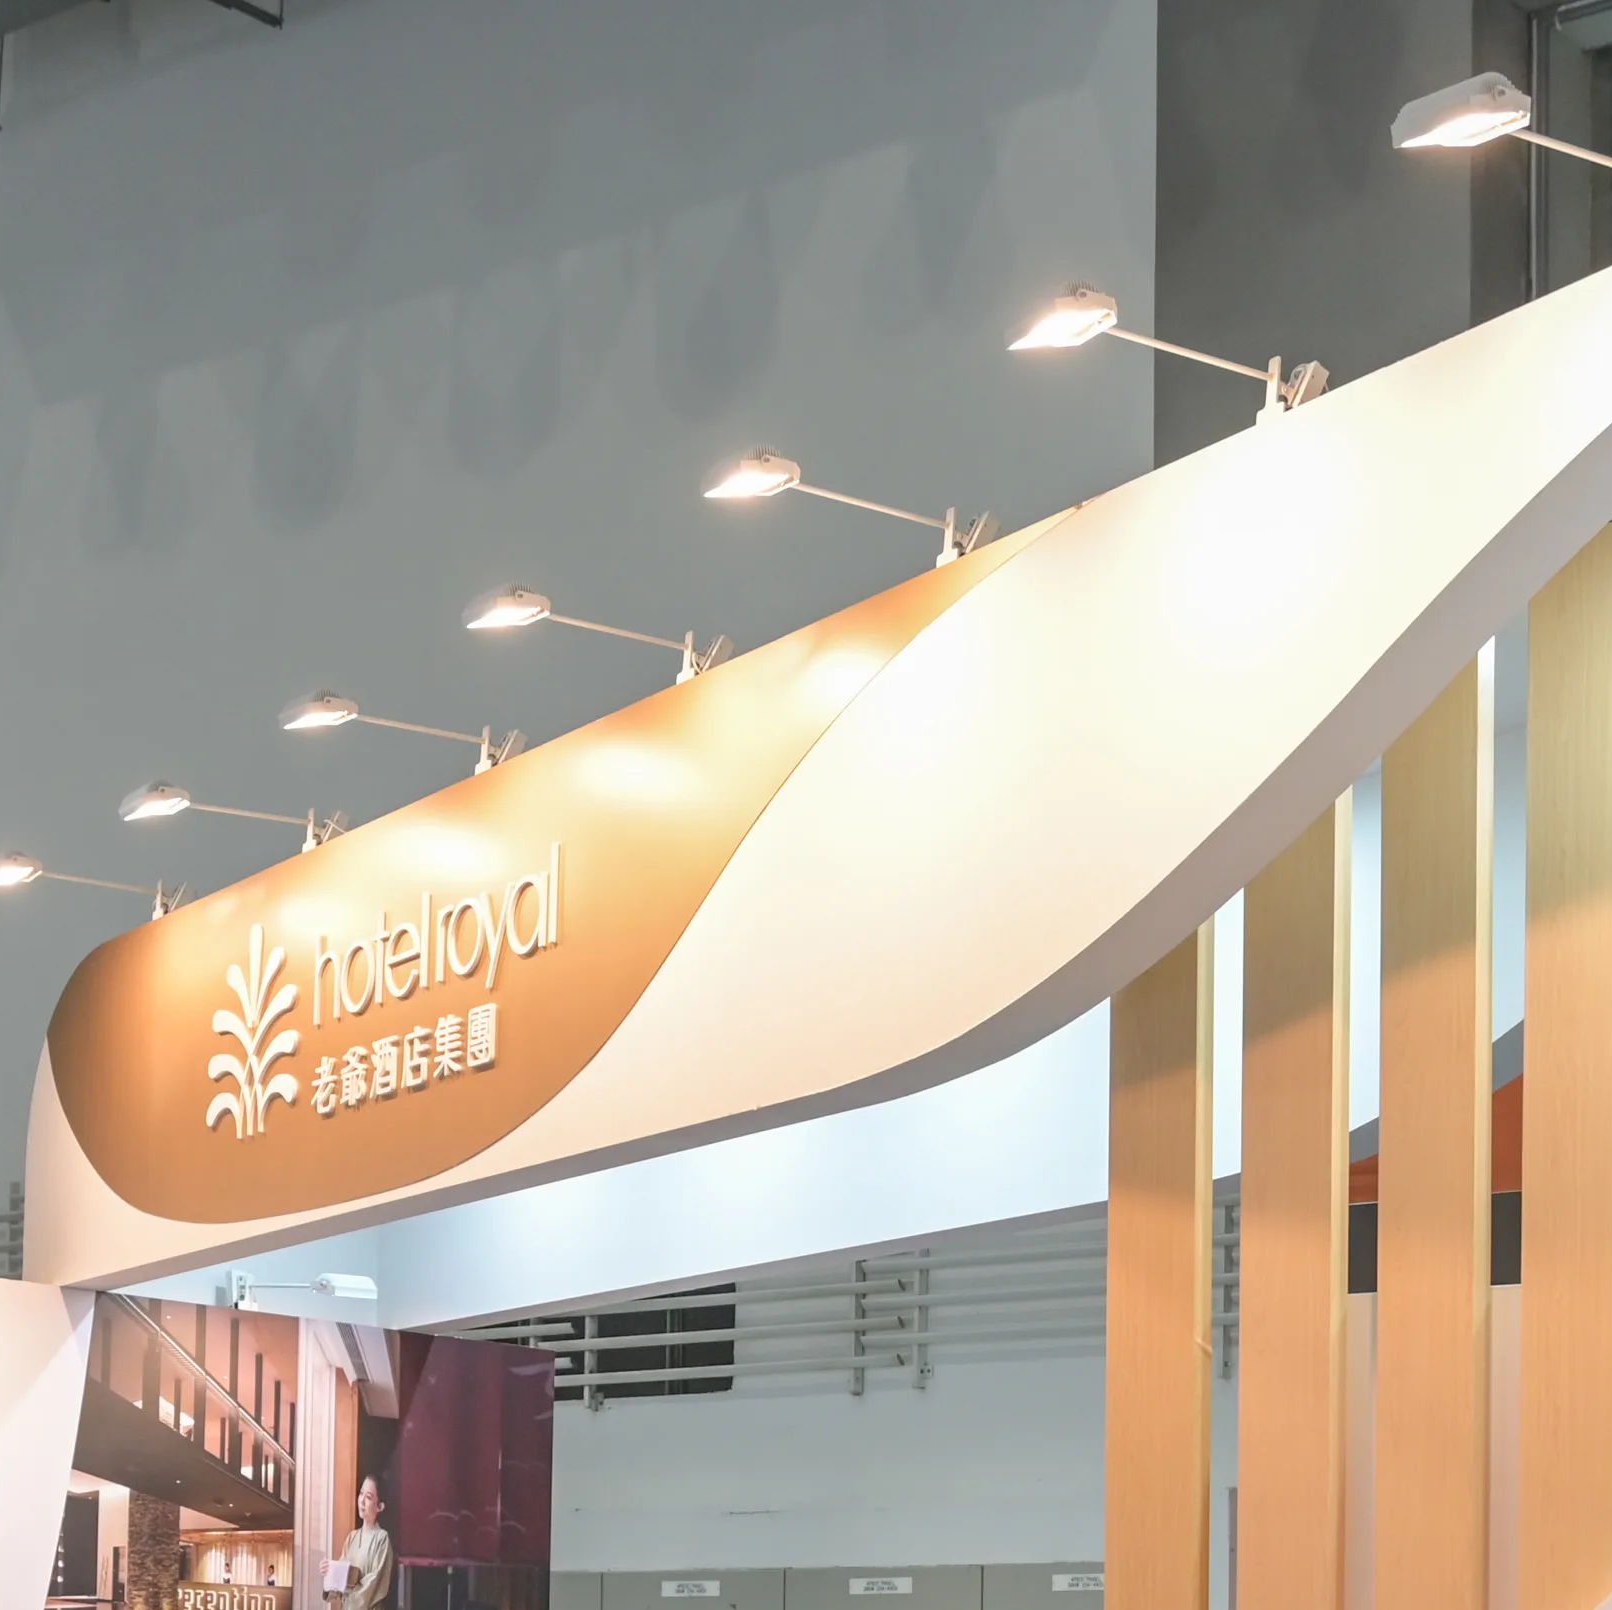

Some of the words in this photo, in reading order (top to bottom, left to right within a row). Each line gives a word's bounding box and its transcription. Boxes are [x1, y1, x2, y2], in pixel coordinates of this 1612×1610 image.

[312, 892, 431, 1027] hotel
[435, 841, 561, 989] royal
[310, 1002, 499, 1116] 老爺酒店集團
